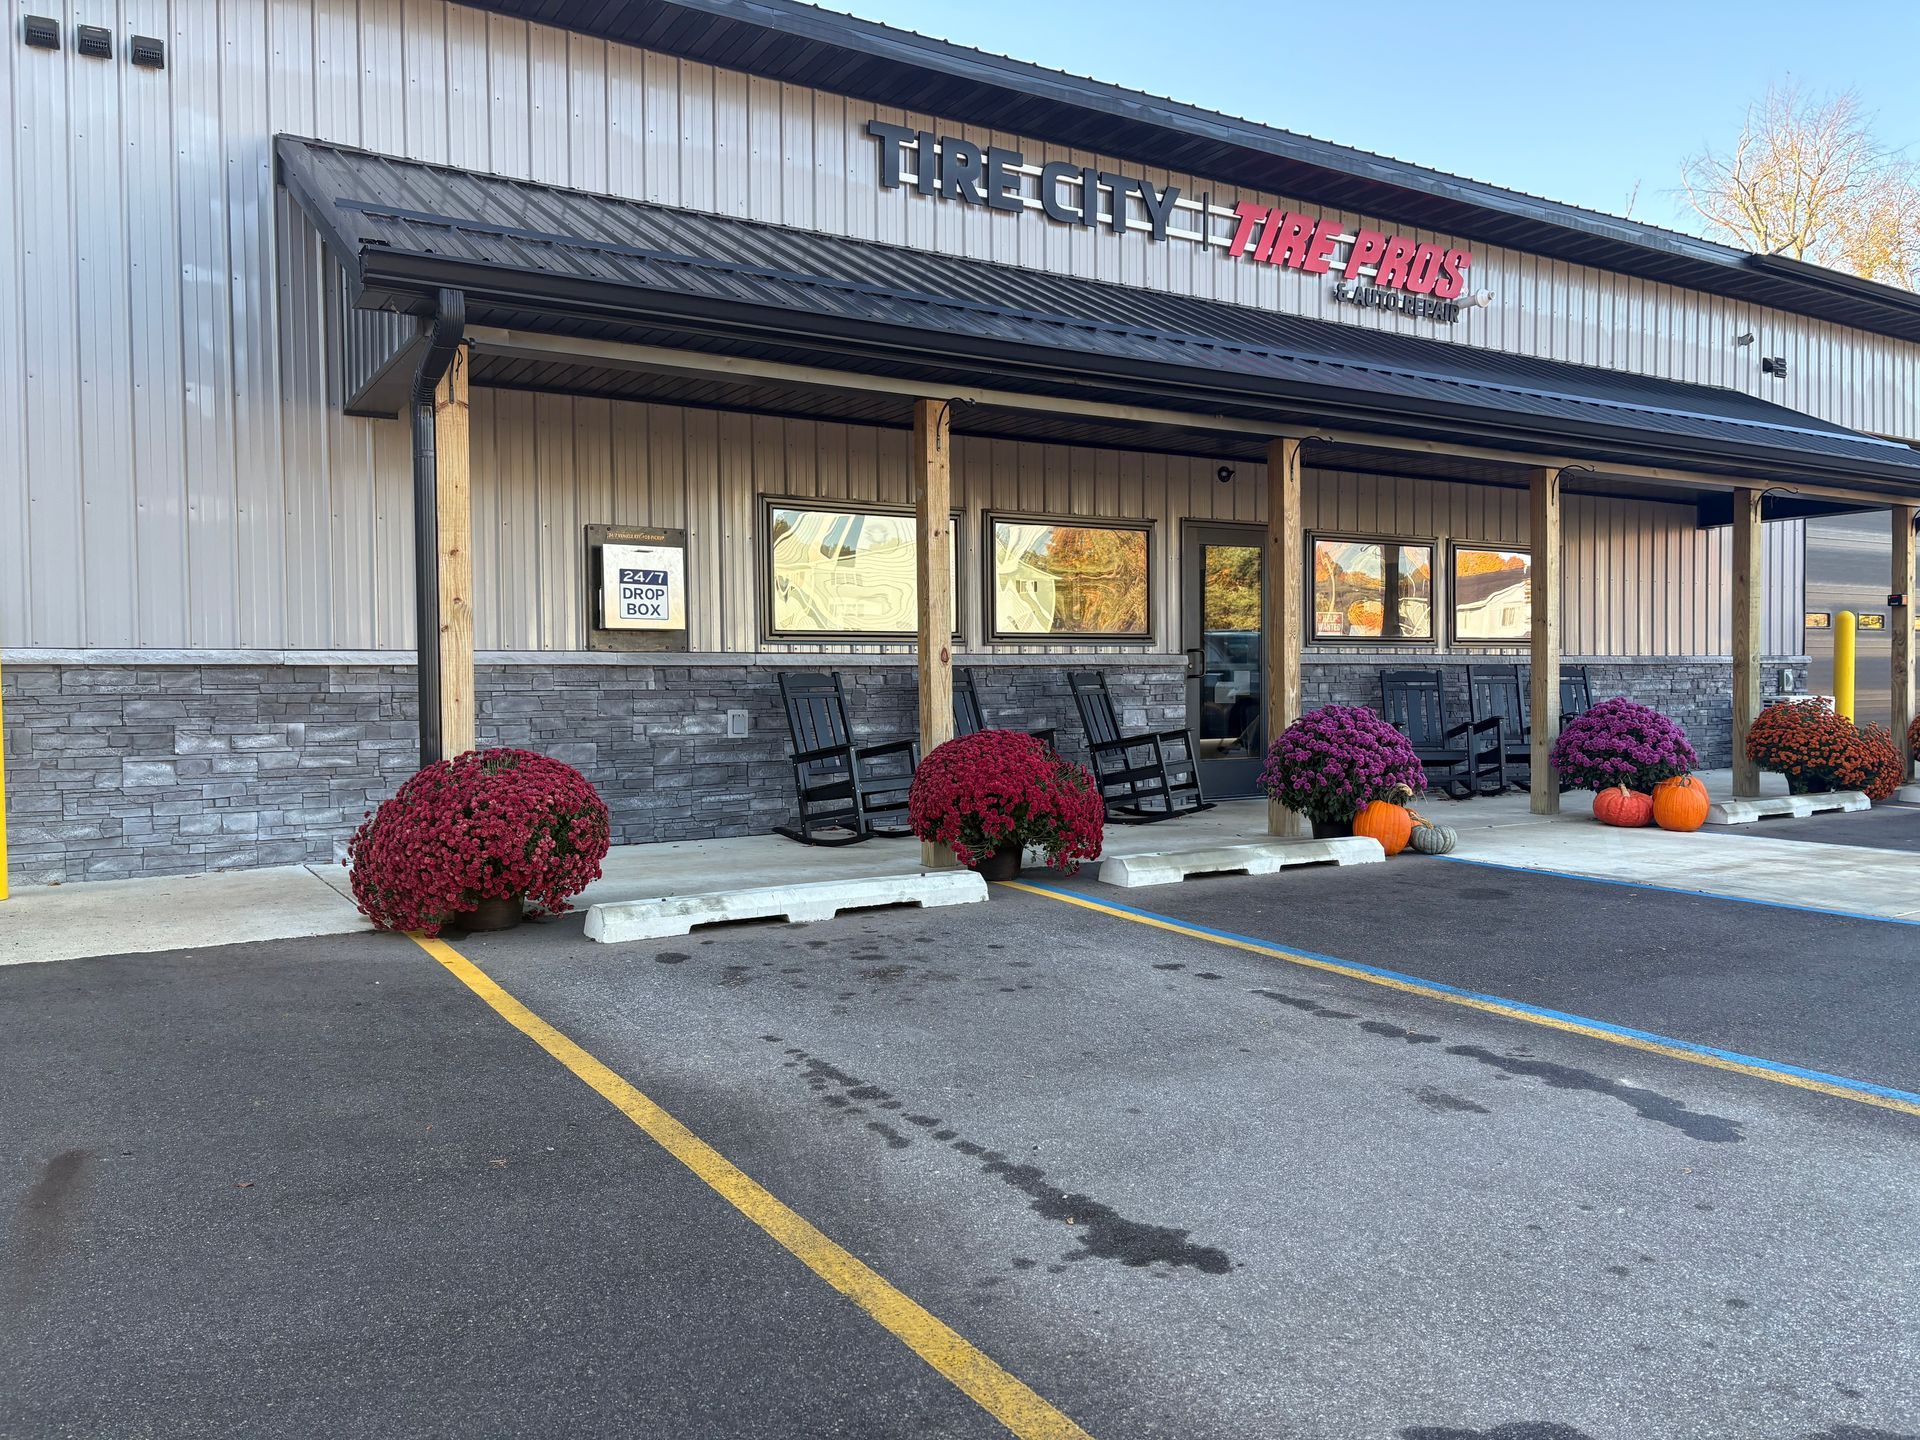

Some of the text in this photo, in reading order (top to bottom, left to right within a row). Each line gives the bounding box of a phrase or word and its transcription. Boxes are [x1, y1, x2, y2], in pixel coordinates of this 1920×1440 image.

[868, 119, 1181, 242] TIRE CITY
[1229, 201, 1472, 299] TIRE PROS
[1335, 283, 1460, 323] & AUTO REPAIR
[623, 571, 664, 583] 24/7
[623, 587, 664, 600] DROP
[627, 603, 660, 616] BOX
